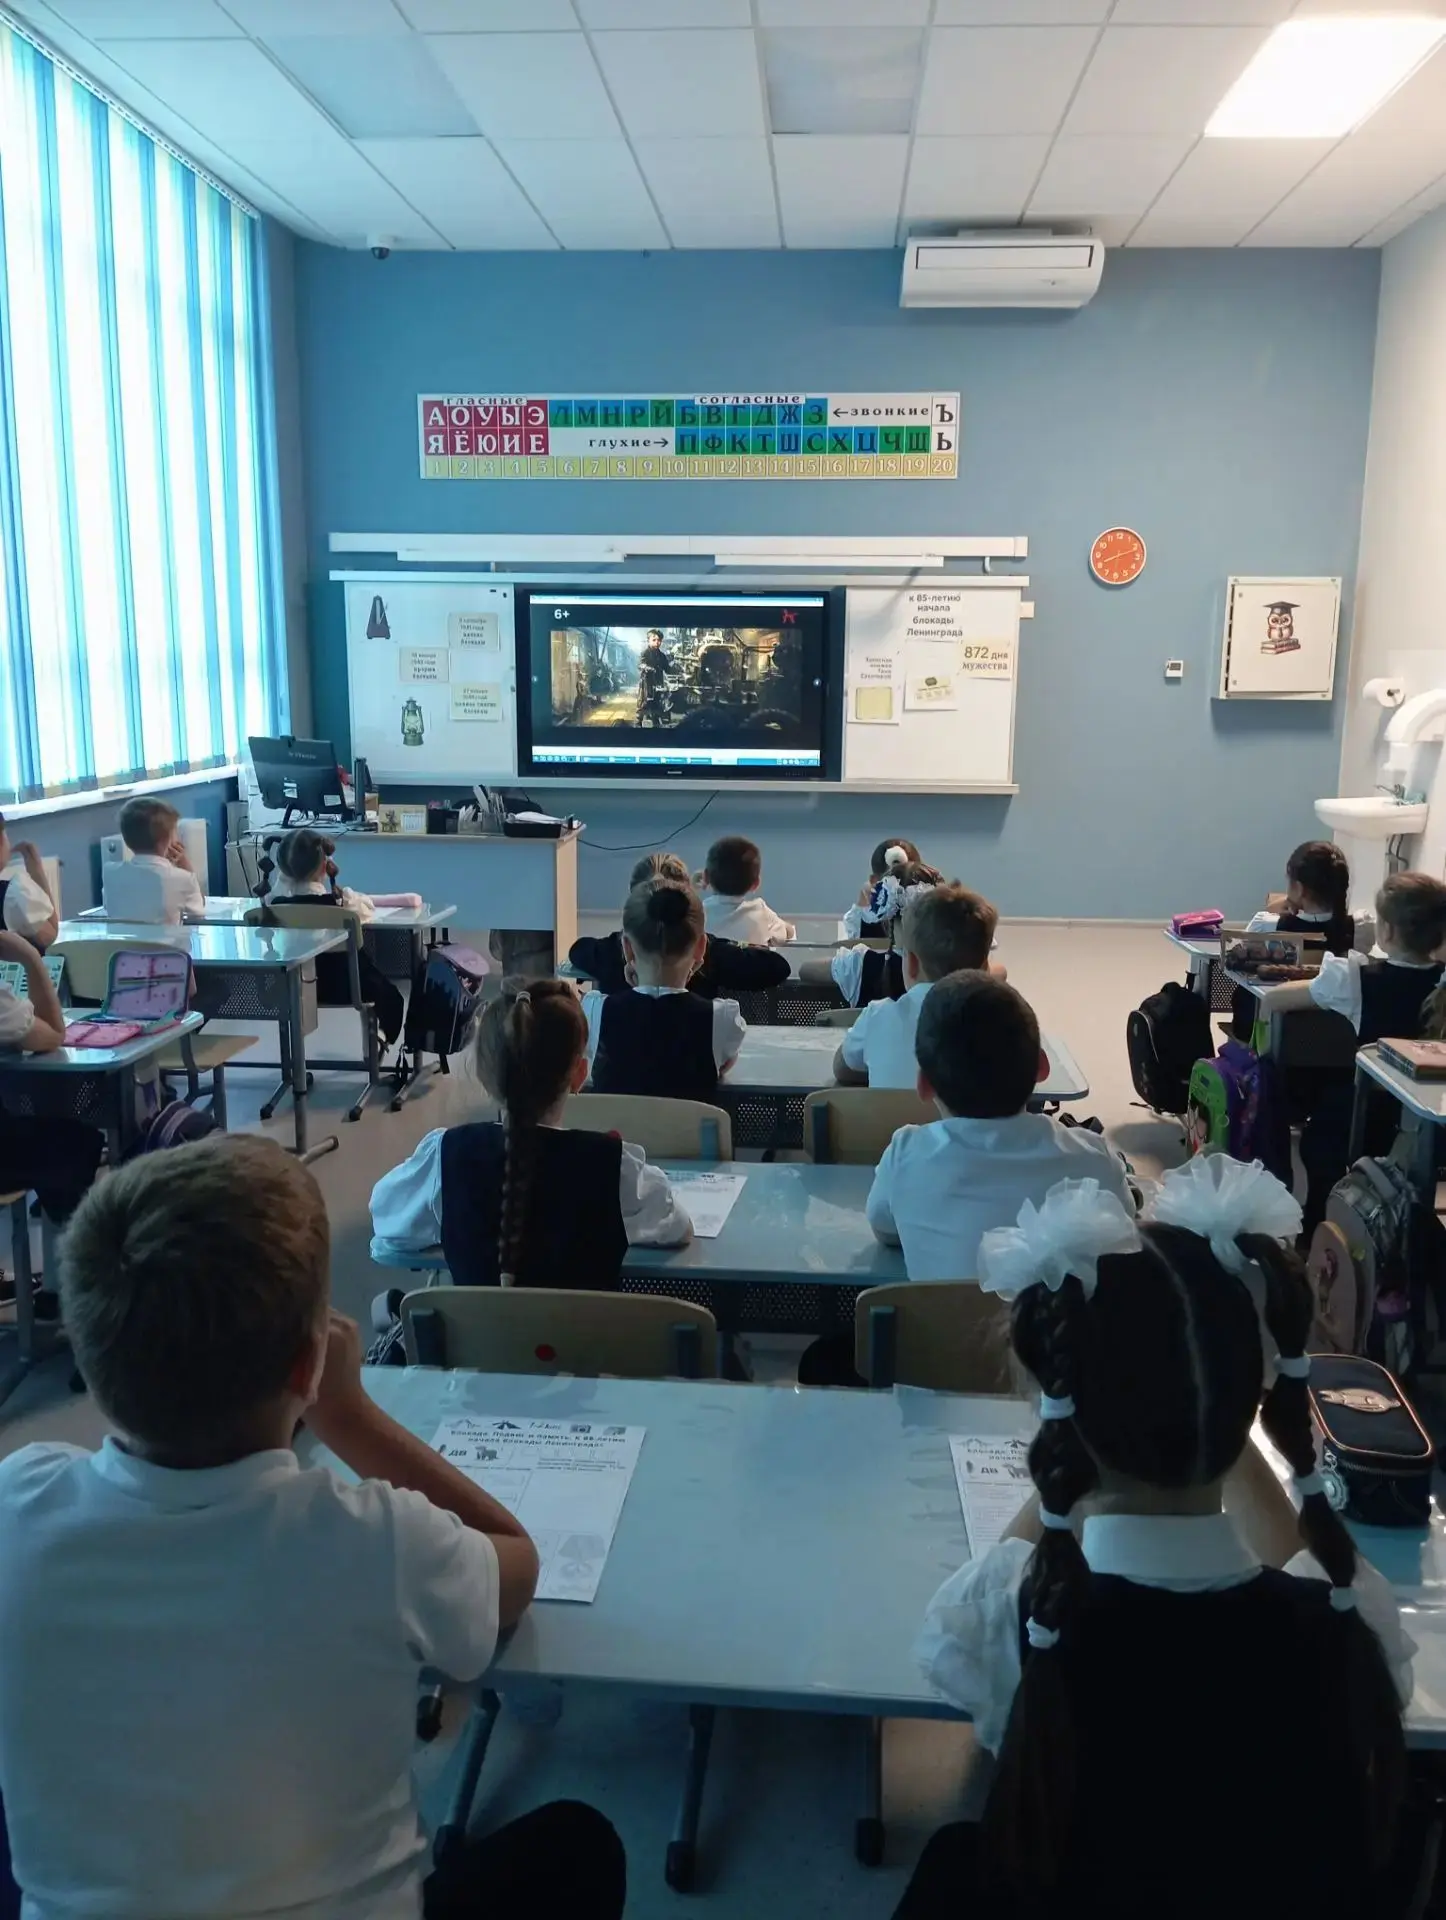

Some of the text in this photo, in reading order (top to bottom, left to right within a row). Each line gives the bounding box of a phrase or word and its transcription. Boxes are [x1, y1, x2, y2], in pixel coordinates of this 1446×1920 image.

[446, 397, 524, 406] гласные
[700, 395, 800, 404] согласные
[850, 406, 928, 416] звонкие
[589, 438, 651, 450] глухие
[433, 461, 952, 474] 1 2 3 4 5 6 7 8 9 10 11 12 13 14 15 16 17 18 19 20
[917, 594, 961, 602] 85-летию
[918, 605, 951, 613] начала
[554, 609, 569, 619] 6+
[913, 617, 954, 625] блокады
[907, 628, 963, 638] Ленинграда
[964, 646, 1009, 661] 872 дня
[962, 662, 1009, 671] мужества
